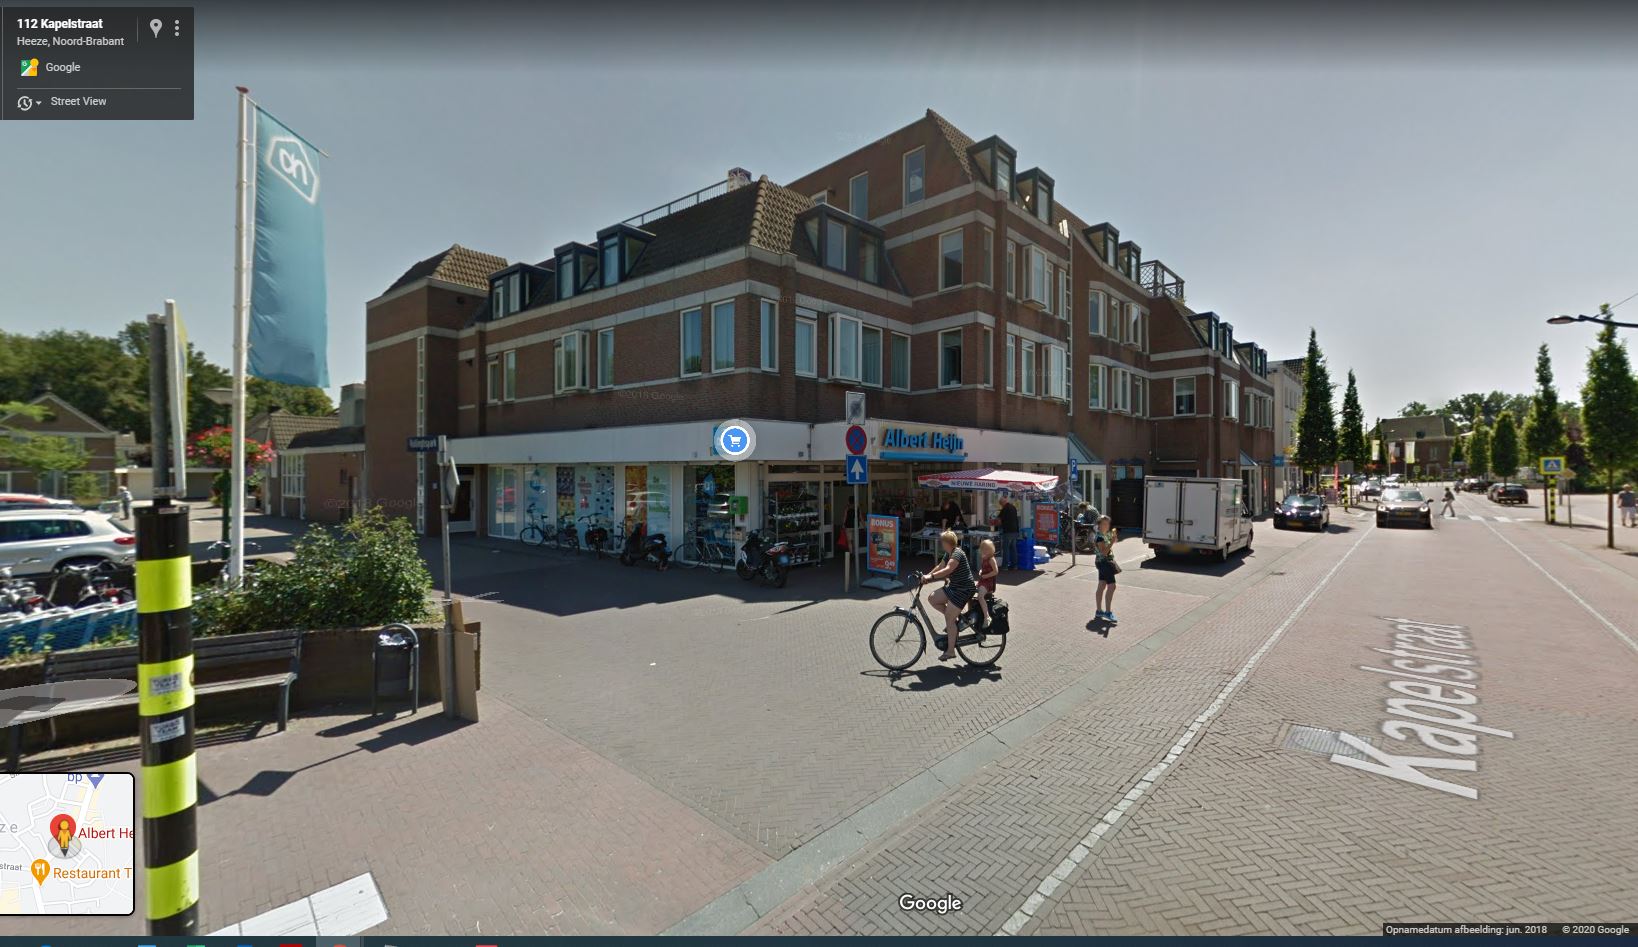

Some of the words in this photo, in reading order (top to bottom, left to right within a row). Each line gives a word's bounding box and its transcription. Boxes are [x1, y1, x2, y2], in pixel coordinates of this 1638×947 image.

[884, 426, 929, 449] Albert
[932, 431, 965, 454] Heijn
[950, 480, 973, 488] NIEUWE
[870, 518, 895, 528] BONUS
[1330, 617, 1514, 800] Kapelstraat
